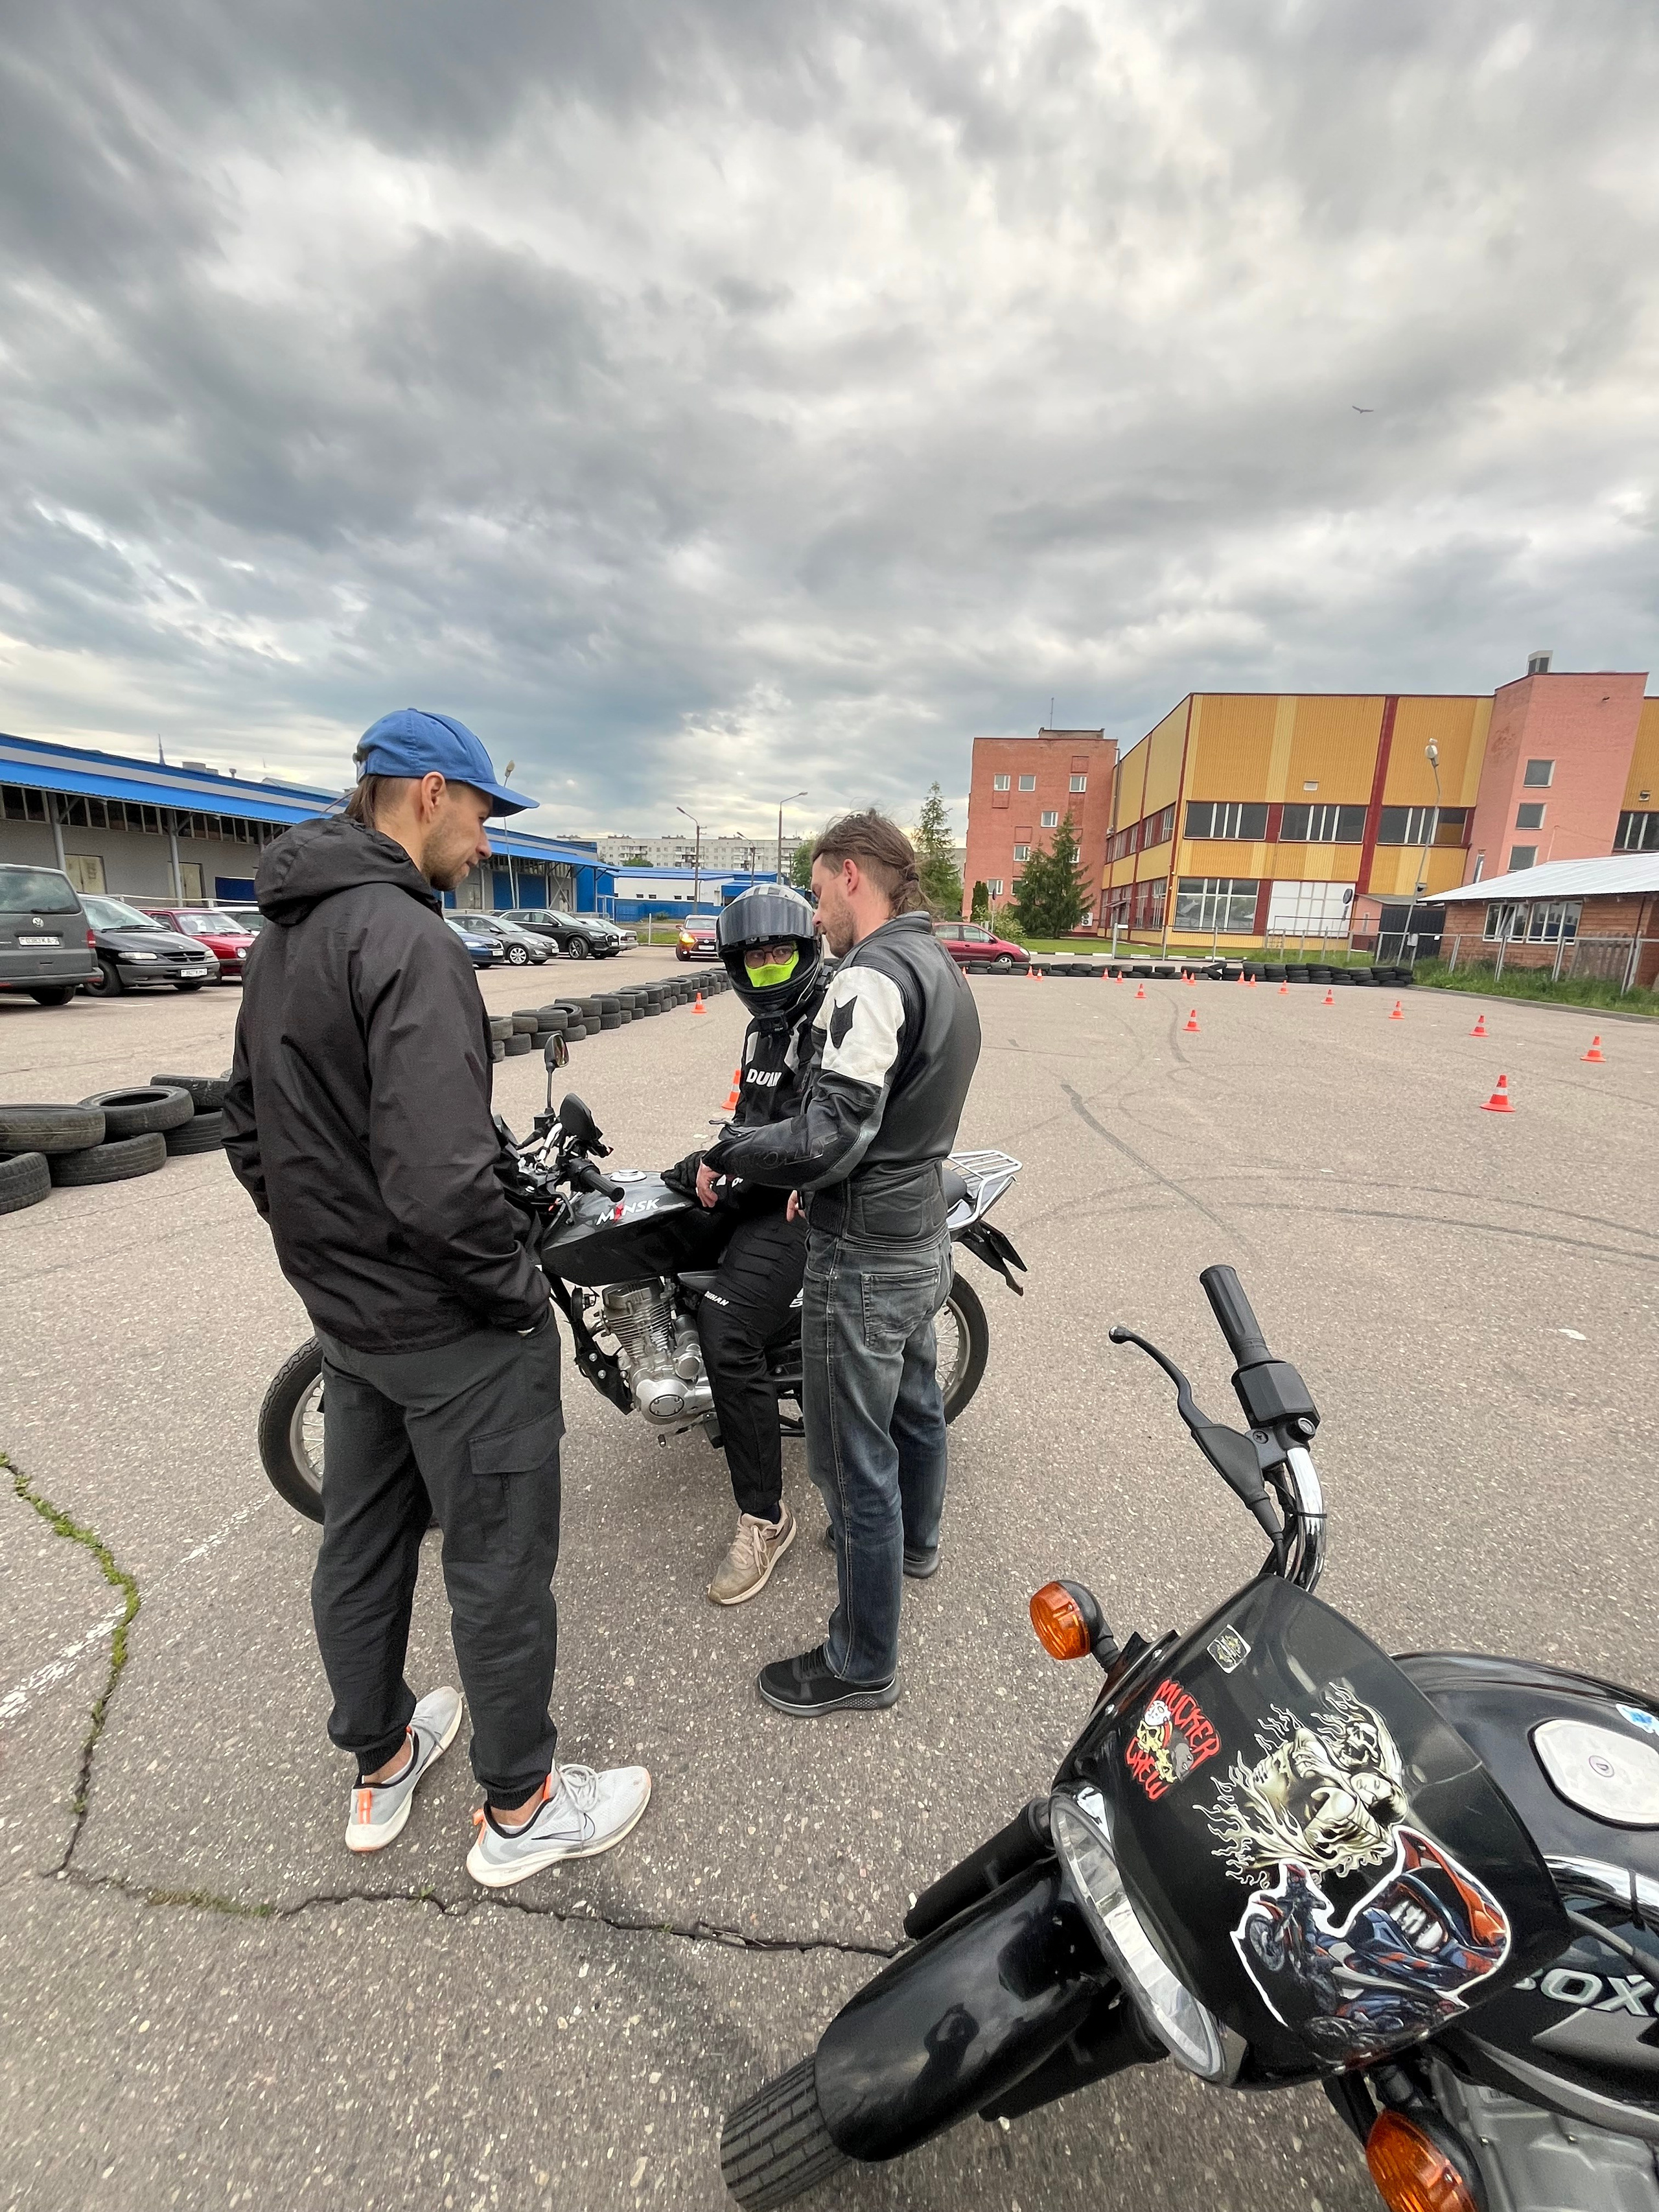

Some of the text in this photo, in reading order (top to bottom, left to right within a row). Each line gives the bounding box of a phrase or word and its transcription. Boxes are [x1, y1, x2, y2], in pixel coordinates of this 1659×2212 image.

[596, 1198, 660, 1225] MINSK
[1144, 1679, 1220, 1770] MUCKER
[1512, 1968, 1659, 2016] OX
